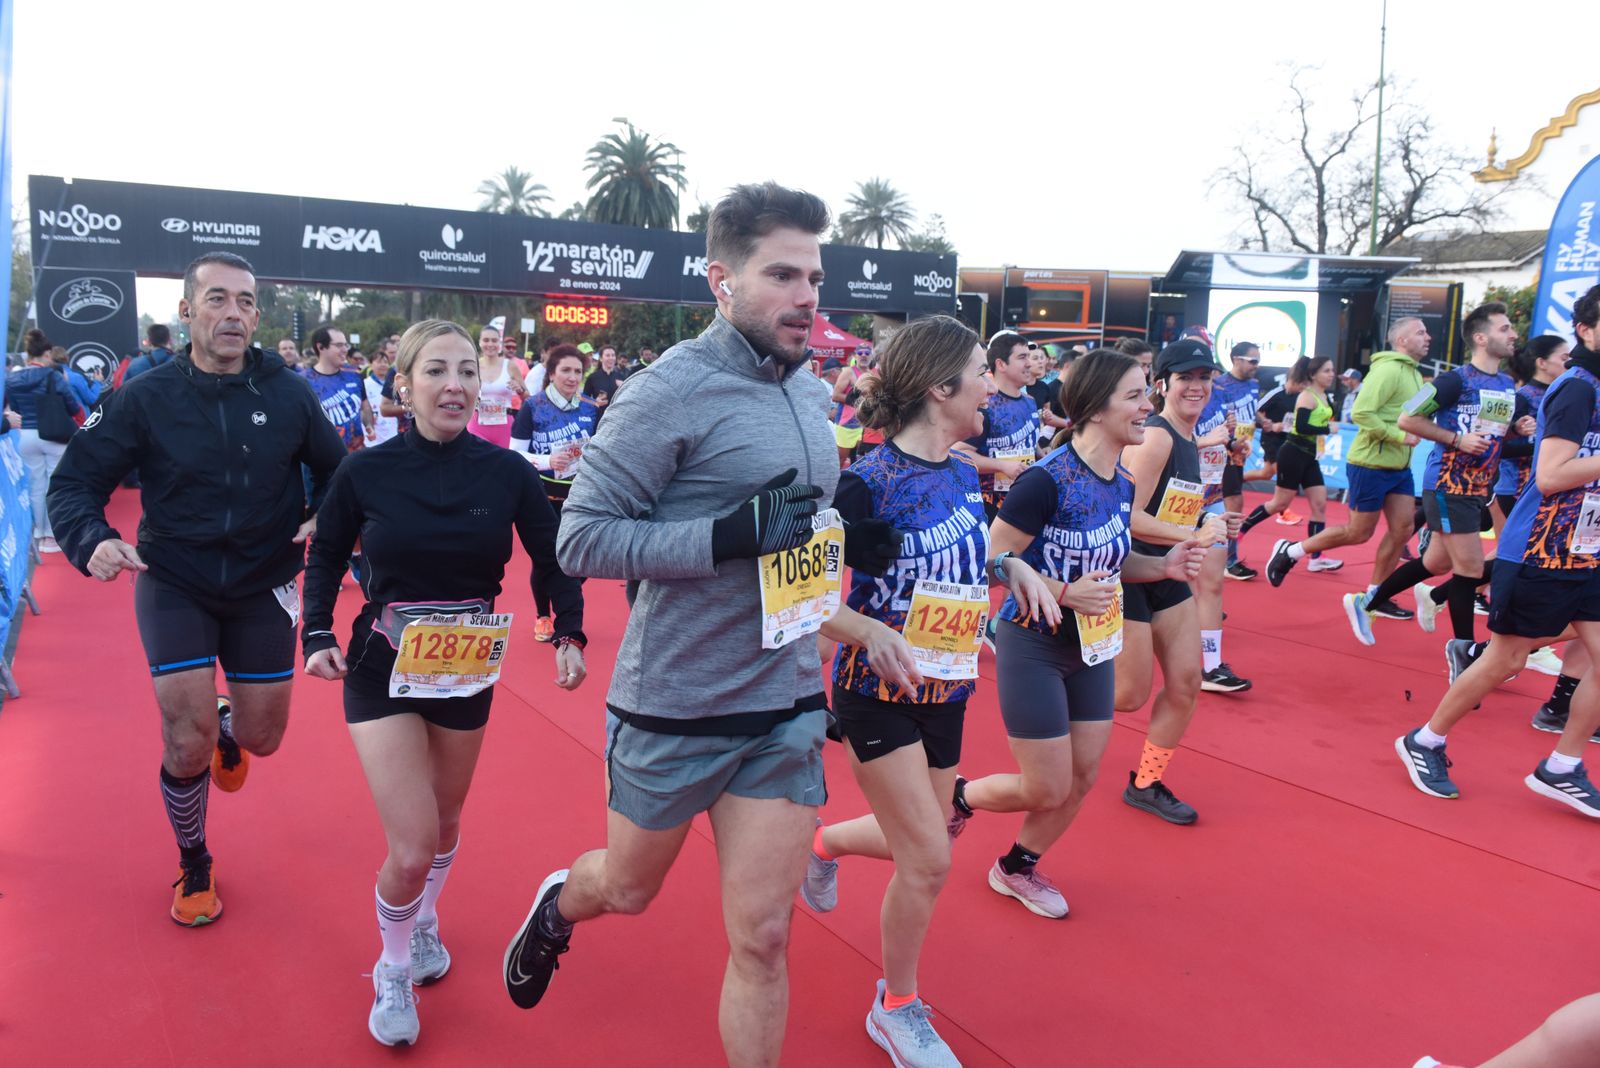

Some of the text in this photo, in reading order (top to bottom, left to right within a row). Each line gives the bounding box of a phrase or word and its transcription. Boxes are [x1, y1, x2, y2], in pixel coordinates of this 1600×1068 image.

[192, 221, 261, 236] HYUNDAI
[1568, 201, 1596, 272] HUMAN
[192, 234, 260, 246] Hyundauto Motor
[302, 225, 384, 253] HOKA
[548, 242, 635, 263] maratón
[1555, 243, 1572, 272] FLY
[425, 264, 480, 273] Healthcare Partner
[571, 257, 637, 279] sevilla
[560, 279, 621, 291] 28 enero 2024
[545, 305, 608, 325] 00:06:33
[1486, 401, 1508, 416] 9165
[548, 422, 580, 442] MARATÓN
[919, 506, 978, 554] MARATÓN
[1043, 513, 1125, 549] MEDIO MARATÓN
[921, 581, 938, 592] MEDIO
[938, 583, 961, 595] MARATÓN
[470, 614, 500, 627] SEVILLA
[918, 604, 981, 637] 12434
[410, 633, 492, 660] 12878
